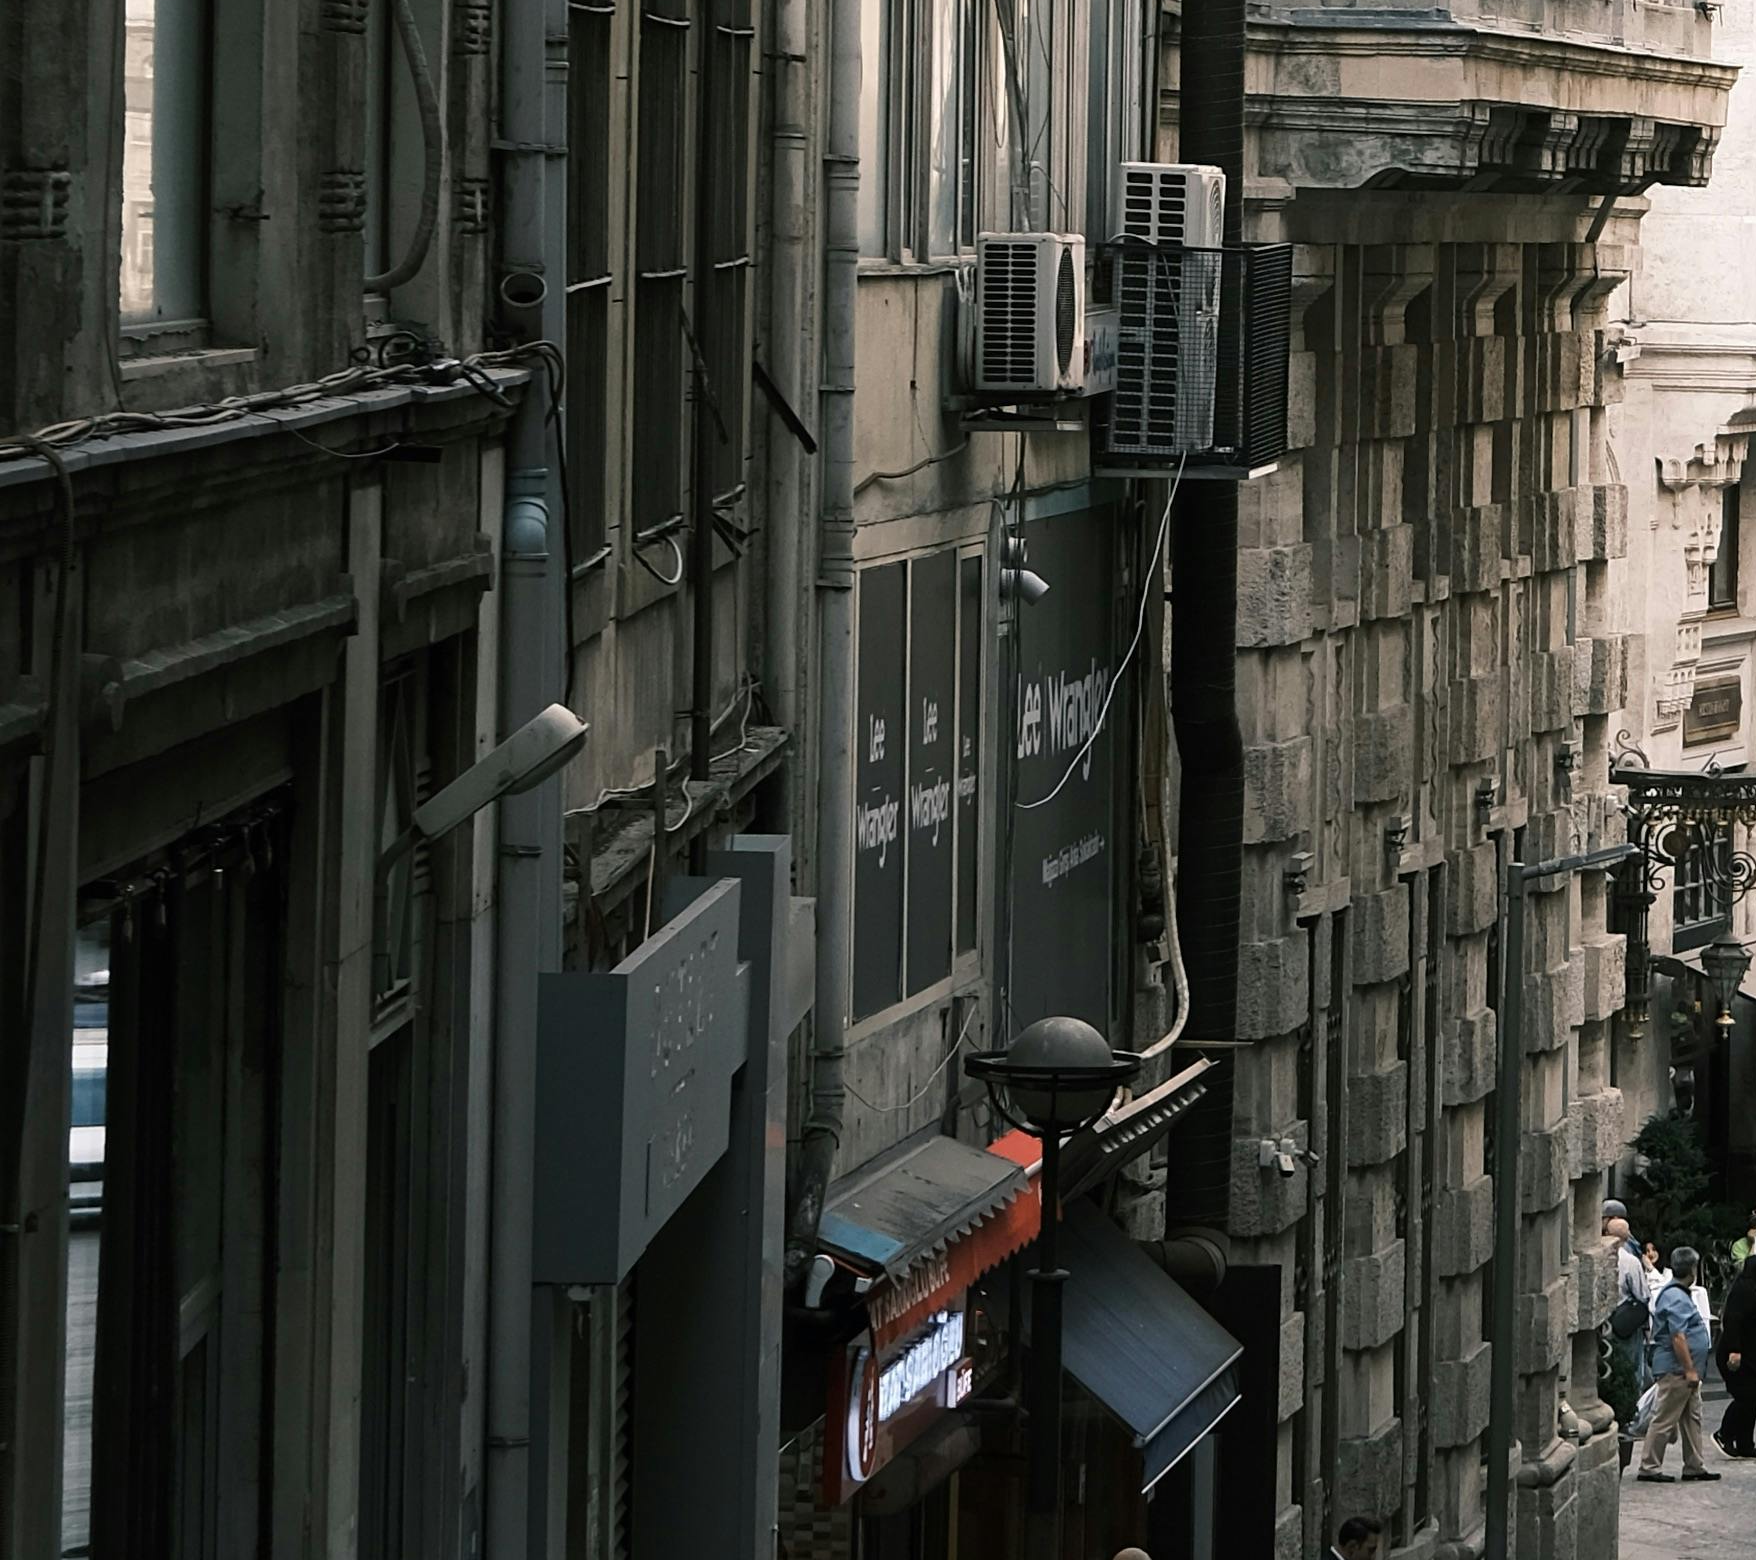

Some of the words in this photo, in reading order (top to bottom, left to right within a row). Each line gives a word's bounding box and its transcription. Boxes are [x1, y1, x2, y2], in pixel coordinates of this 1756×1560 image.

[869, 714, 885, 763] Lee
[922, 697, 938, 745] Lee
[1017, 673, 1041, 759] Lee
[1048, 657, 1108, 780] Wrangler
[857, 795, 899, 868] Wrangler
[911, 776, 950, 846] Wrangler
